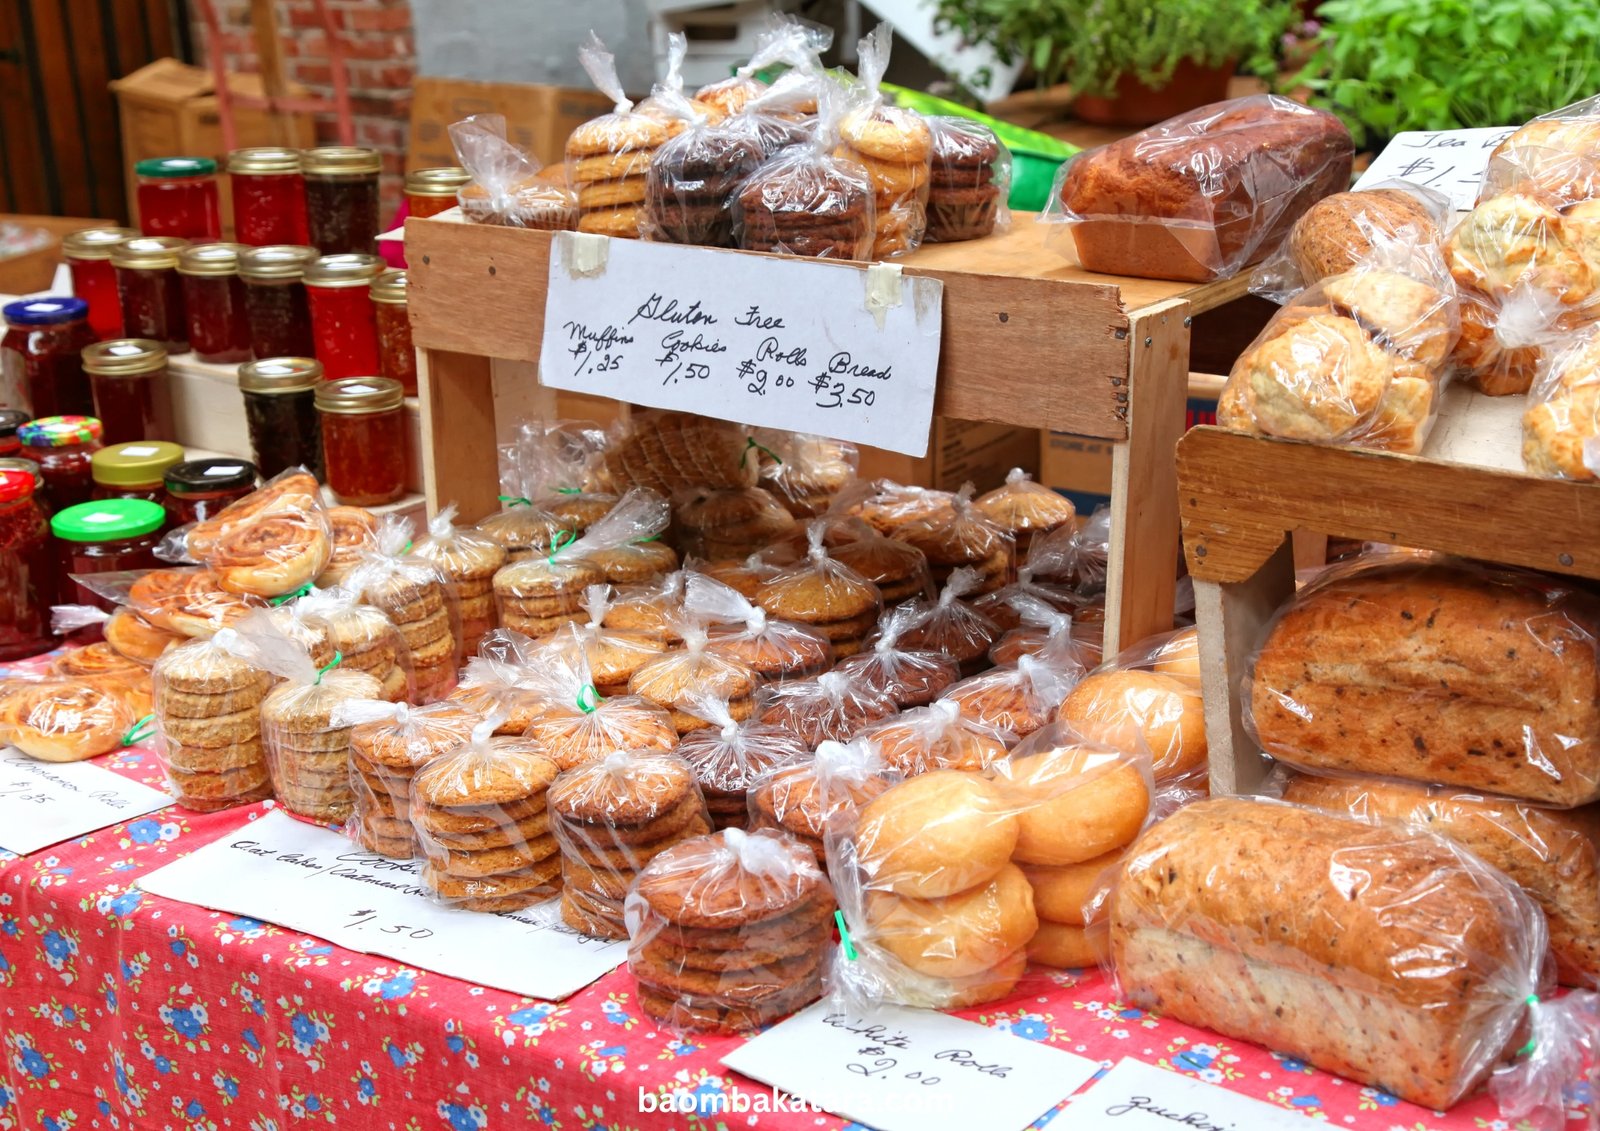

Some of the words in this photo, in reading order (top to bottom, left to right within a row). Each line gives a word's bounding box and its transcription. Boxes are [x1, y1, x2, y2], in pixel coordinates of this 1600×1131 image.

[628, 293, 718, 325] Gluten
[734, 306, 785, 330] Free
[563, 321, 634, 351] Muffins
[661, 330, 727, 354] Cookies
[757, 337, 807, 367] Rolls
[829, 352, 892, 380] Bread
[568, 340, 624, 376] $1.25
[655, 351, 710, 386] $1.50
[736, 359, 794, 396] $2.00
[808, 372, 875, 407] $3.50
[934, 1049, 1013, 1078] Rolls
